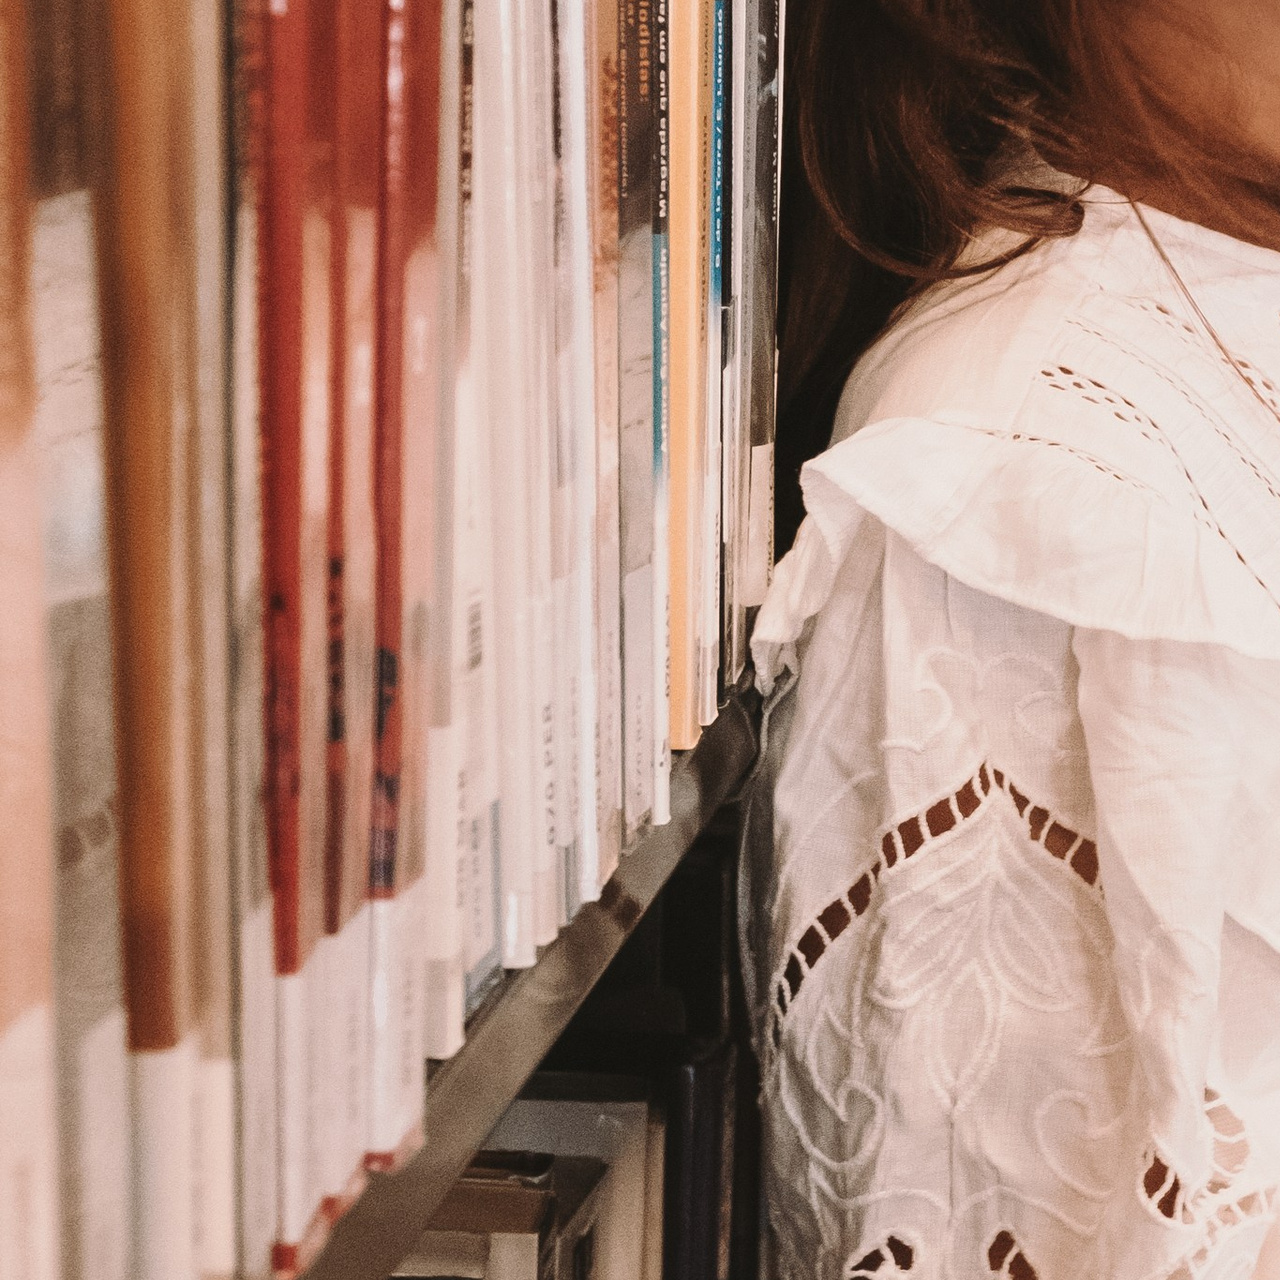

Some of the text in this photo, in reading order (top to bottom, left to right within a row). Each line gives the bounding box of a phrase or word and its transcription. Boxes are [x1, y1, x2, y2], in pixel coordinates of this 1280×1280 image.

[659, 30, 666, 64] em
[659, 70, 668, 111] que
[658, 117, 668, 218] M'agrada
